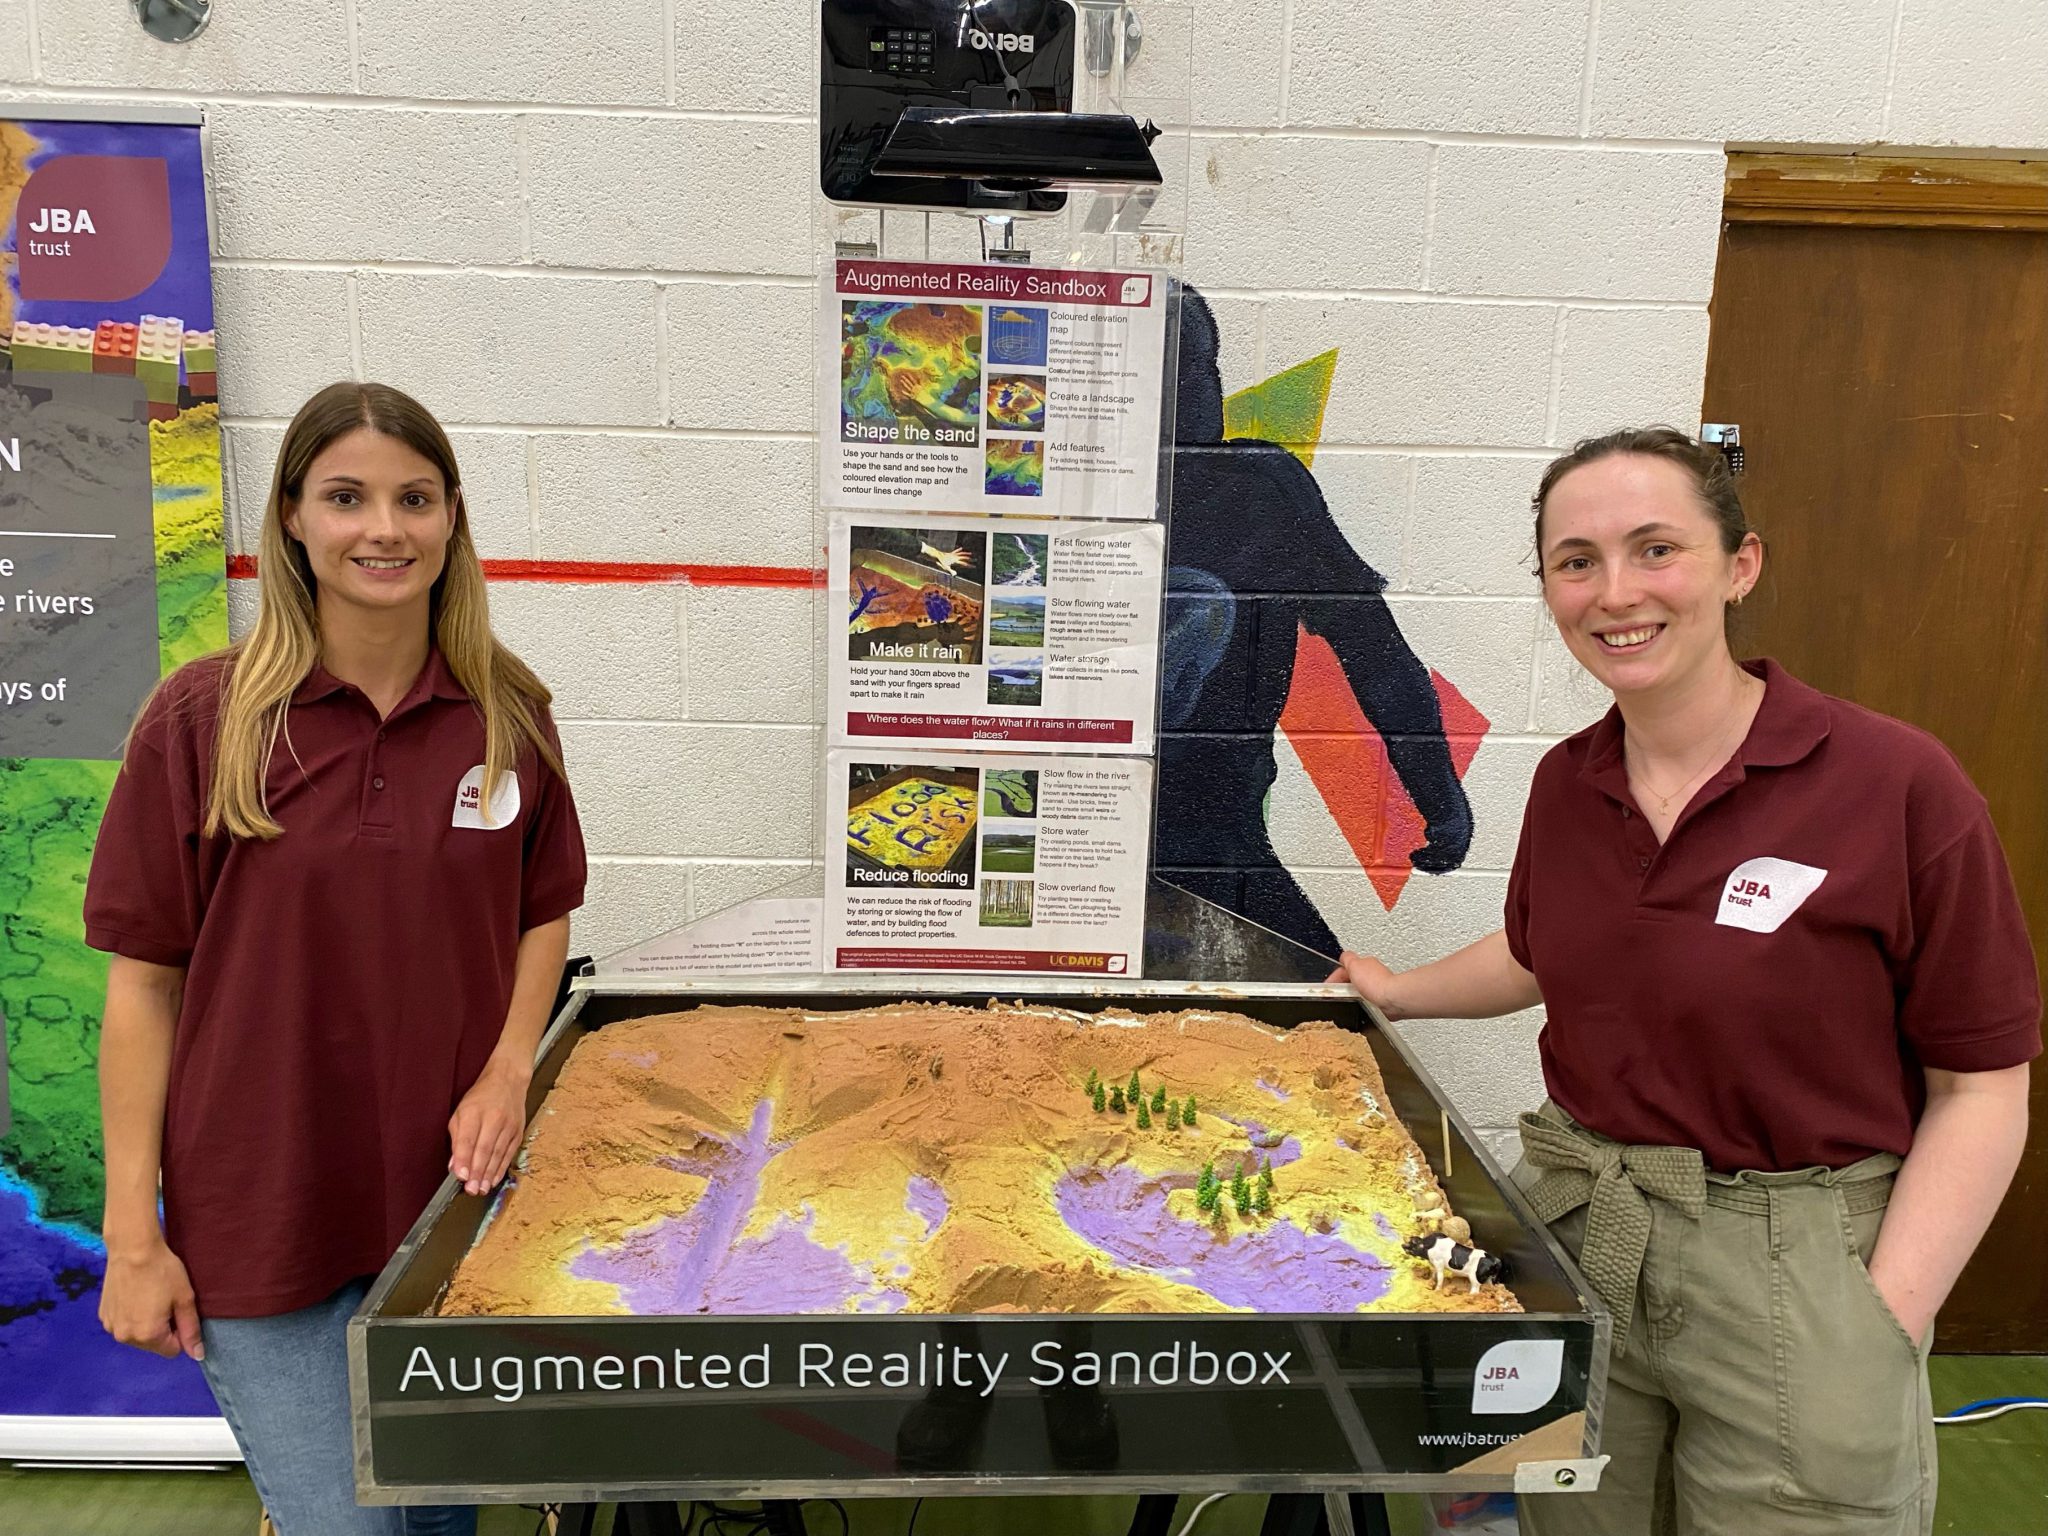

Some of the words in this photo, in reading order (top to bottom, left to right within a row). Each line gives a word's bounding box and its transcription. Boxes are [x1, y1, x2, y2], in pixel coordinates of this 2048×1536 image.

[968, 28, 1035, 54] BenQ
[28, 208, 96, 234] JBA
[29, 240, 71, 256] trust
[844, 268, 950, 291] Augmented
[957, 273, 1020, 297] Reality
[1026, 275, 1106, 297] Sandbox
[1051, 312, 1088, 321] Coloured
[1091, 314, 1128, 323] elevation
[1050, 326, 1068, 334] map
[1050, 392, 1079, 400] Create
[1090, 394, 1134, 404] landscape
[846, 422, 898, 442] Shape
[904, 425, 929, 440] the
[935, 427, 975, 442] sand
[1050, 442, 1067, 451] Add
[1070, 443, 1104, 452] features
[843, 449, 858, 457] Use
[860, 451, 878, 459] your
[880, 451, 903, 459] hands
[916, 452, 928, 460] the
[930, 453, 948, 461] tools
[843, 462, 866, 470] shape
[868, 462, 880, 470] the
[843, 474, 876, 482] coloured
[878, 475, 912, 483] elevation
[843, 485, 871, 493] contour
[874, 486, 891, 494] lines
[894, 488, 922, 497] change
[1054, 538, 1073, 546] Fast
[1075, 539, 1104, 549] flowing
[1108, 540, 1131, 548] water
[15, 589, 94, 615] rivers
[1052, 598, 1072, 606] Slow
[1075, 599, 1104, 609] flowing
[1107, 600, 1130, 608] water
[870, 642, 914, 657] Make
[919, 644, 928, 658] it
[933, 645, 963, 659] rain
[1050, 654, 1075, 662] Water
[1078, 656, 1109, 664] storage
[851, 667, 868, 675] Hold
[41, 677, 67, 701] of
[907, 681, 932, 689] fingers
[867, 714, 898, 723] Where
[900, 715, 923, 724] does
[926, 716, 940, 724] the
[943, 717, 969, 725] water
[972, 717, 996, 726] flow?
[999, 718, 1023, 727] What
[1026, 718, 1032, 728] if
[1034, 719, 1039, 728] it
[1042, 720, 1064, 729] rains
[1067, 720, 1074, 728] in
[1078, 720, 1114, 730] different
[973, 730, 1009, 740] places?
[1044, 770, 1065, 778] Slow
[1067, 770, 1084, 778] flow
[1111, 772, 1130, 780] river
[462, 786, 479, 798] JB
[460, 800, 478, 809] trust
[1041, 827, 1063, 835] Store
[854, 869, 909, 882] Reduce
[912, 870, 968, 886] flooding
[1038, 883, 1058, 891] Slow
[1732, 879, 1771, 899] JBA
[943, 899, 971, 907] flooding
[1728, 894, 1753, 907] trust
[847, 908, 855, 916] by
[895, 909, 922, 917] slowing
[899, 920, 926, 928] building
[891, 931, 917, 939] protect
[399, 1343, 771, 1403] Augmented
[799, 1341, 1009, 1398] Reality
[1028, 1340, 1293, 1387] Sandbox
[1483, 1367, 1519, 1380] JBA
[1481, 1383, 1504, 1392] trust
